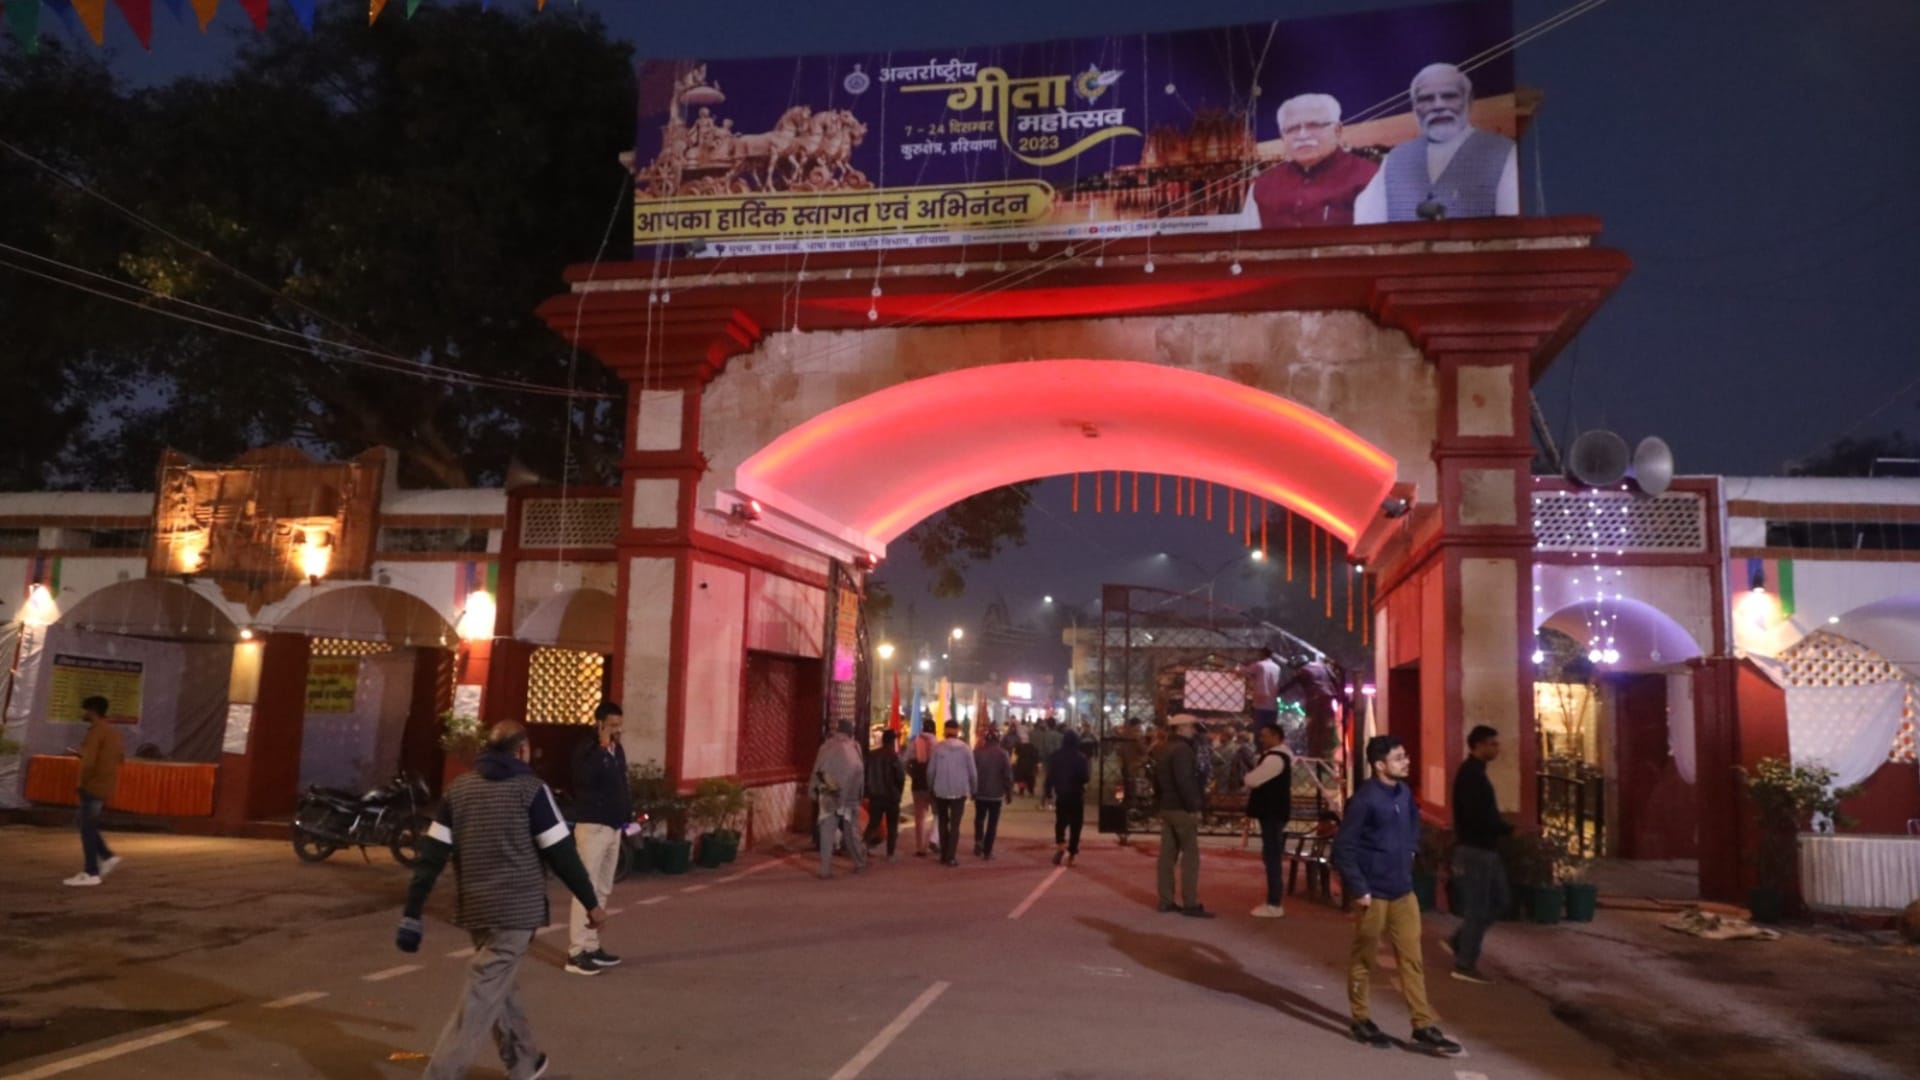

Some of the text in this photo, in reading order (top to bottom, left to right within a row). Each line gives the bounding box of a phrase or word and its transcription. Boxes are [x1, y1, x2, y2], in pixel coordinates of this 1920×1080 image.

[879, 58, 978, 82] अन्तर्राष्ट्रीय
[900, 66, 1071, 150] गीता
[1017, 107, 1126, 132] महोत्सव
[904, 124, 912, 137] 7
[928, 123, 945, 136] 24
[950, 137, 998, 154] हरियाणा
[1018, 135, 1060, 151] 2023
[637, 189, 1031, 232] आपका हार्दिक स्वागत एवं अभिनंदन
